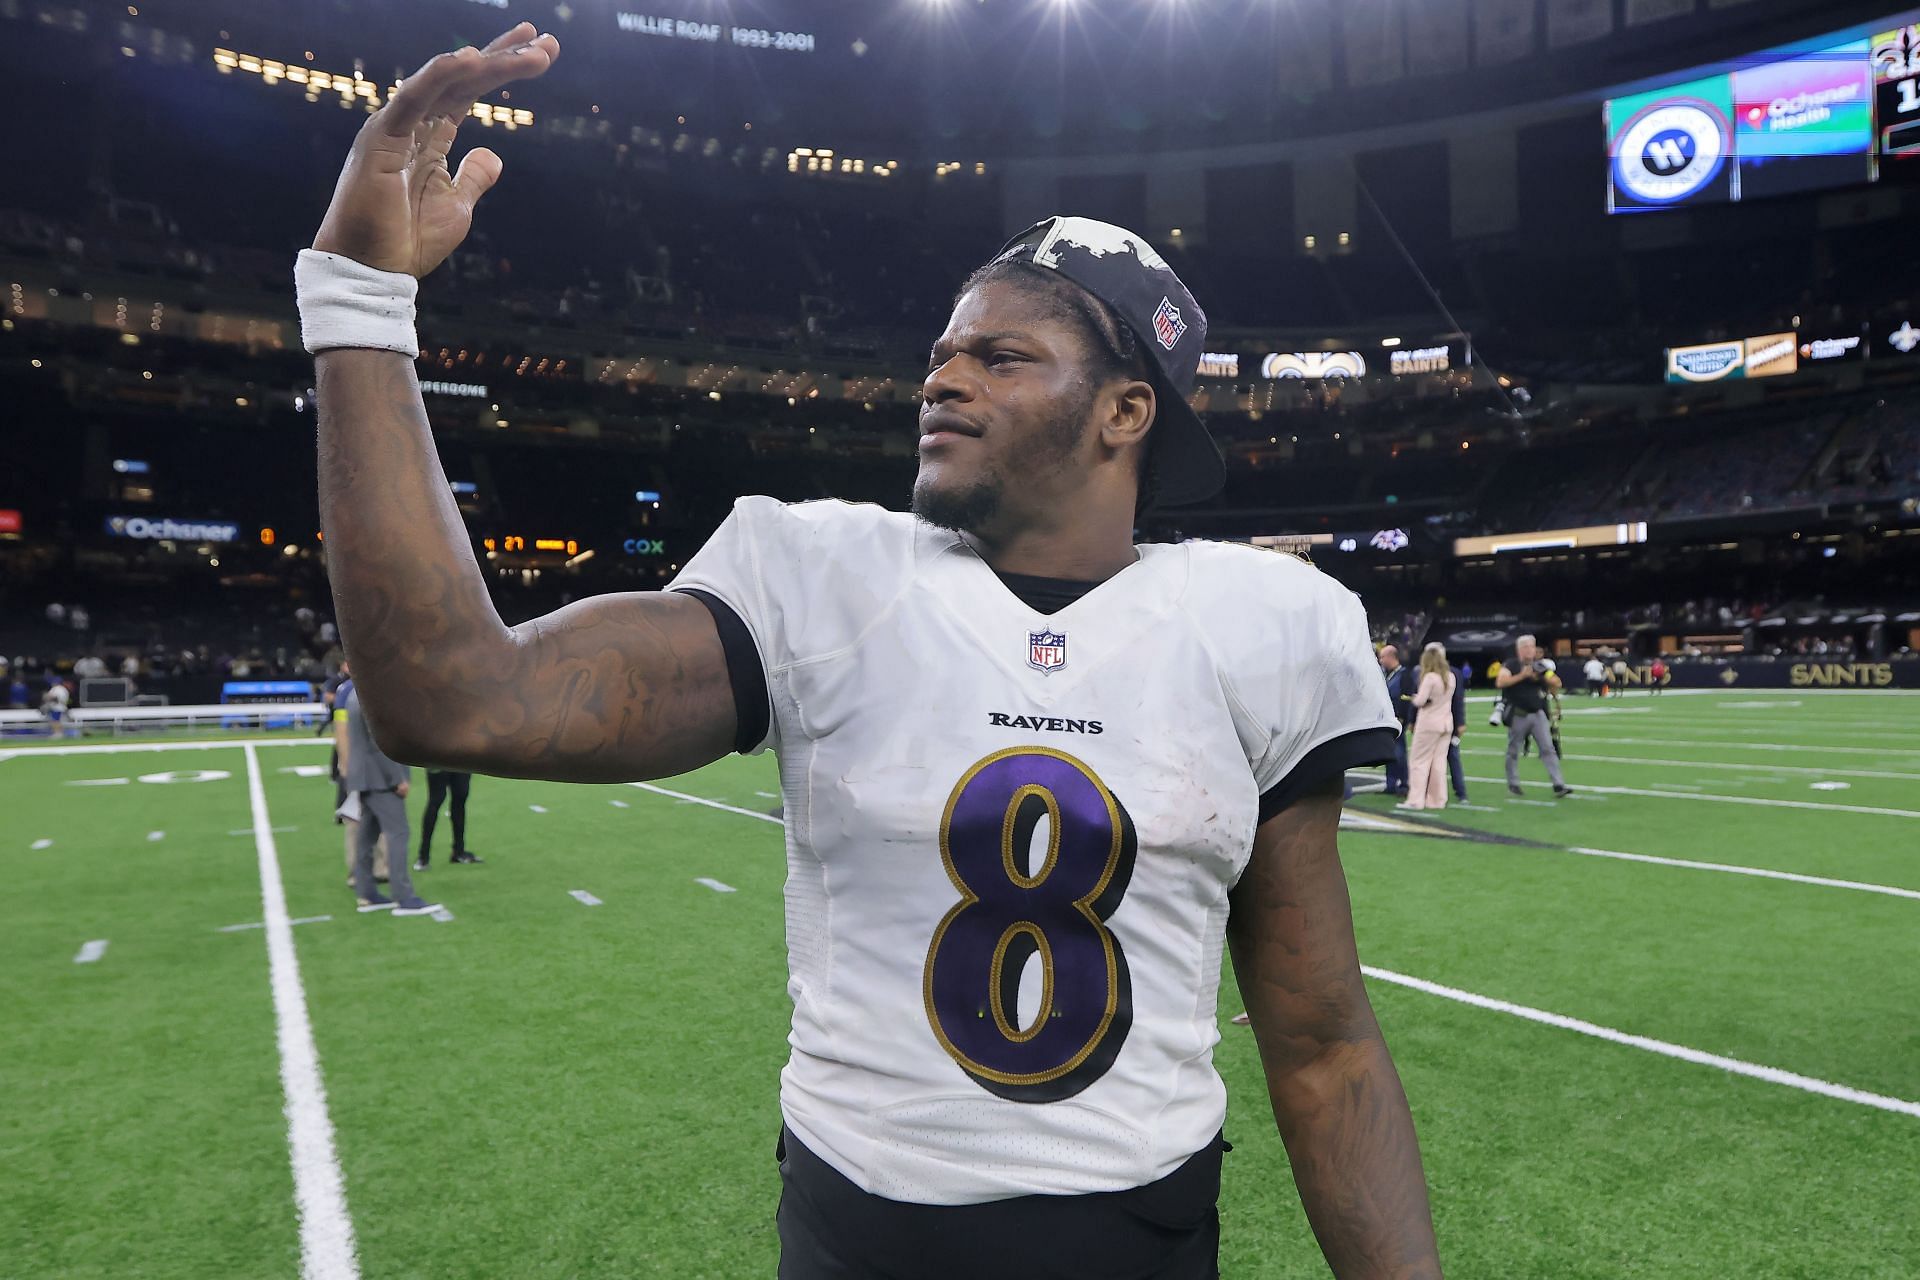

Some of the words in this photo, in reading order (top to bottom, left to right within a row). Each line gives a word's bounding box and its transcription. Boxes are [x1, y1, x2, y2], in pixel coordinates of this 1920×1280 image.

[617, 12, 674, 37] WILLIE
[676, 19, 721, 42] ROAF
[731, 27, 815, 51] 1993-2001
[1767, 82, 1860, 117] Ochsner
[1897, 79, 1920, 113] 1
[1769, 107, 1831, 132] Health
[1157, 312, 1176, 344] NFL
[1196, 360, 1239, 377] AINTS
[1391, 357, 1449, 375] SAINTS
[125, 517, 237, 542] Ochsner
[504, 536, 524, 551] 27
[623, 539, 664, 554] COX
[1033, 646, 1062, 666] NFL
[1790, 663, 1894, 686] SAINTS
[988, 712, 1104, 735] RAVENS
[923, 745, 1138, 1104] 8
